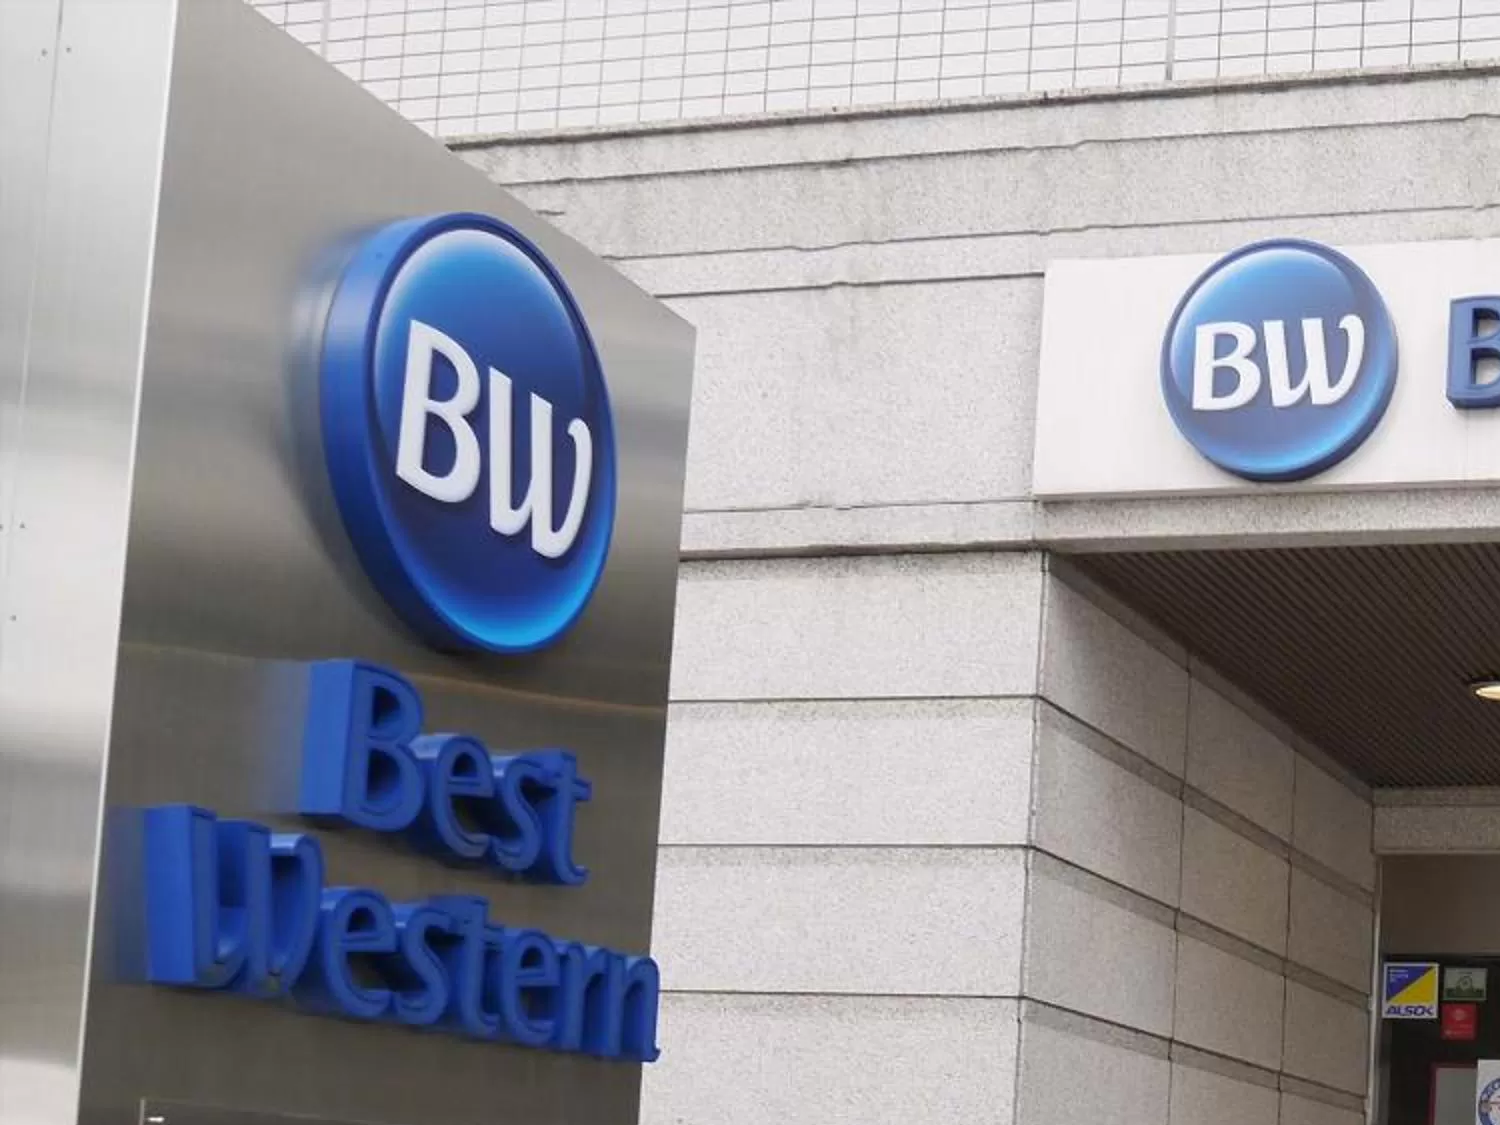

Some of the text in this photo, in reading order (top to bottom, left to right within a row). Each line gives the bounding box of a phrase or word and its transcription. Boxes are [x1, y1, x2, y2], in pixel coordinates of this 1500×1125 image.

[396, 319, 592, 559] BW
[1191, 315, 1366, 412] BW
[302, 659, 592, 886] Best
[145, 804, 661, 1063] Western
[1385, 1005, 1433, 1017] ALSOK
